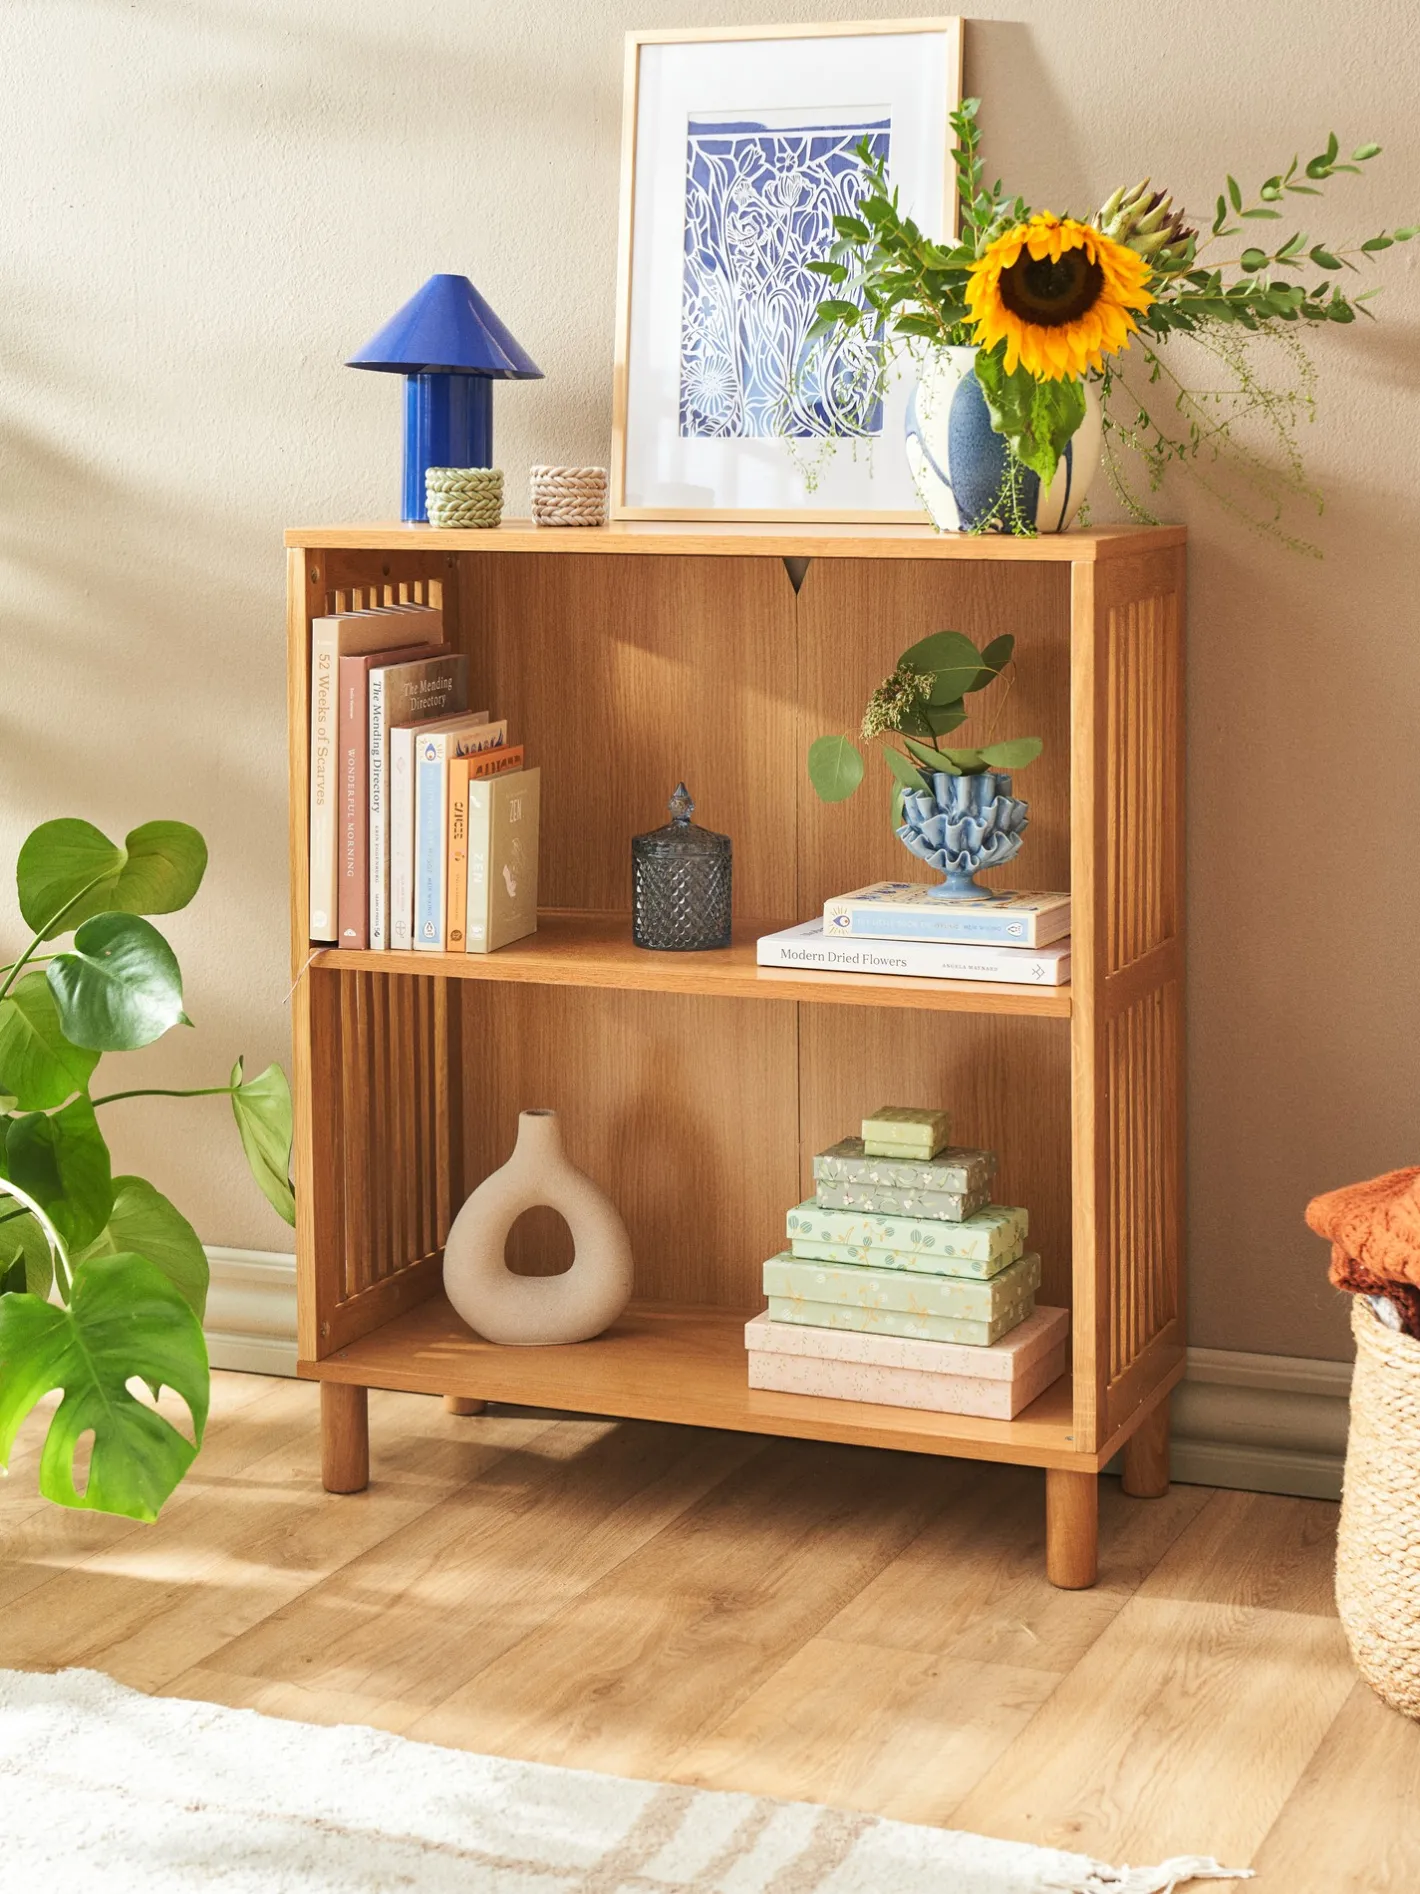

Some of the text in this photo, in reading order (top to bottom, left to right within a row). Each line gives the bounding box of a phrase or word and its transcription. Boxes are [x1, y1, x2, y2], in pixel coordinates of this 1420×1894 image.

[318, 653, 331, 670] 52
[317, 675, 330, 723] Weeks
[403, 676, 453, 697] The Mending
[410, 694, 447, 711] Directory
[317, 727, 330, 745] of
[370, 681, 382, 813] The Mending Directory
[316, 747, 329, 806] Scarves
[346, 748, 356, 877] WONDERFUL MORNING
[509, 798, 522, 823] ZEN
[473, 852, 484, 883] ZEN
[780, 948, 908, 968] Modern Dried Flowers
